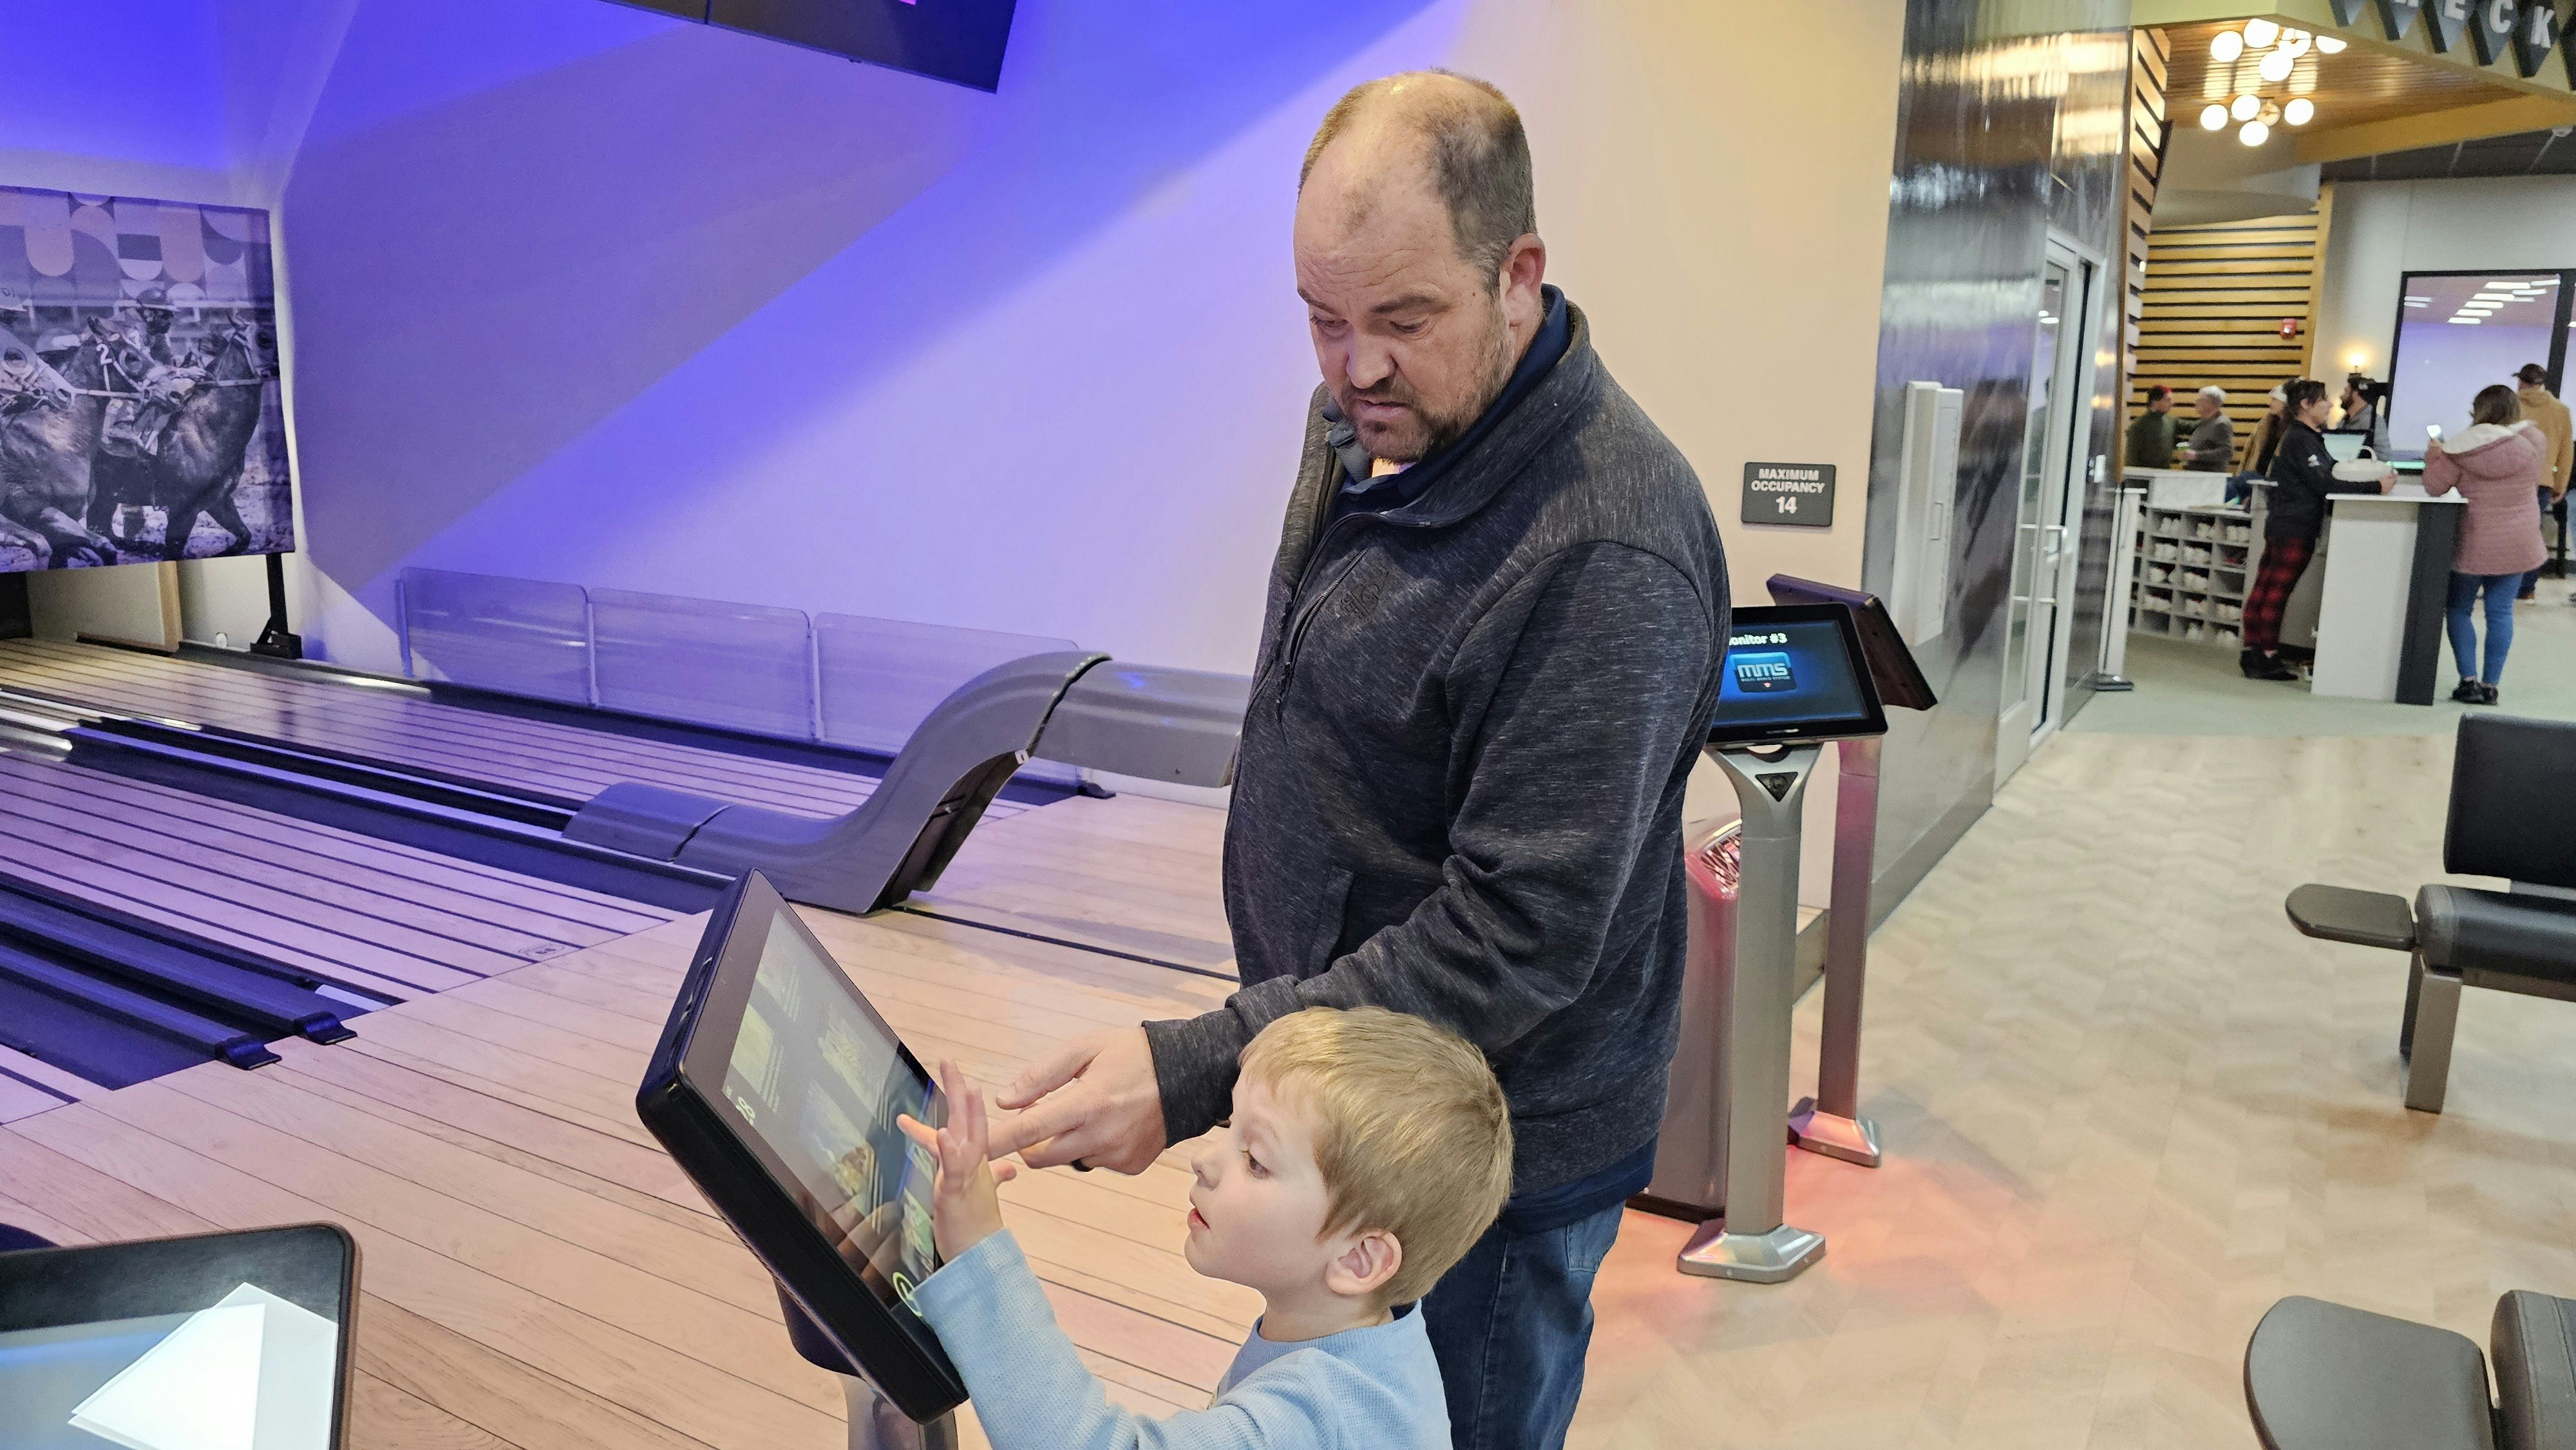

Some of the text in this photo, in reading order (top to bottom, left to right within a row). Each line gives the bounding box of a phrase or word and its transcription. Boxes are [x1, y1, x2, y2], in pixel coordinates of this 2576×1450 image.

[97, 343, 112, 365] 2
[1759, 468, 1819, 481] MAXIMUM
[1751, 480, 1826, 494] OCCUPANCY
[1776, 496, 1798, 514] 14
[1728, 632, 1788, 646] onitor #3
